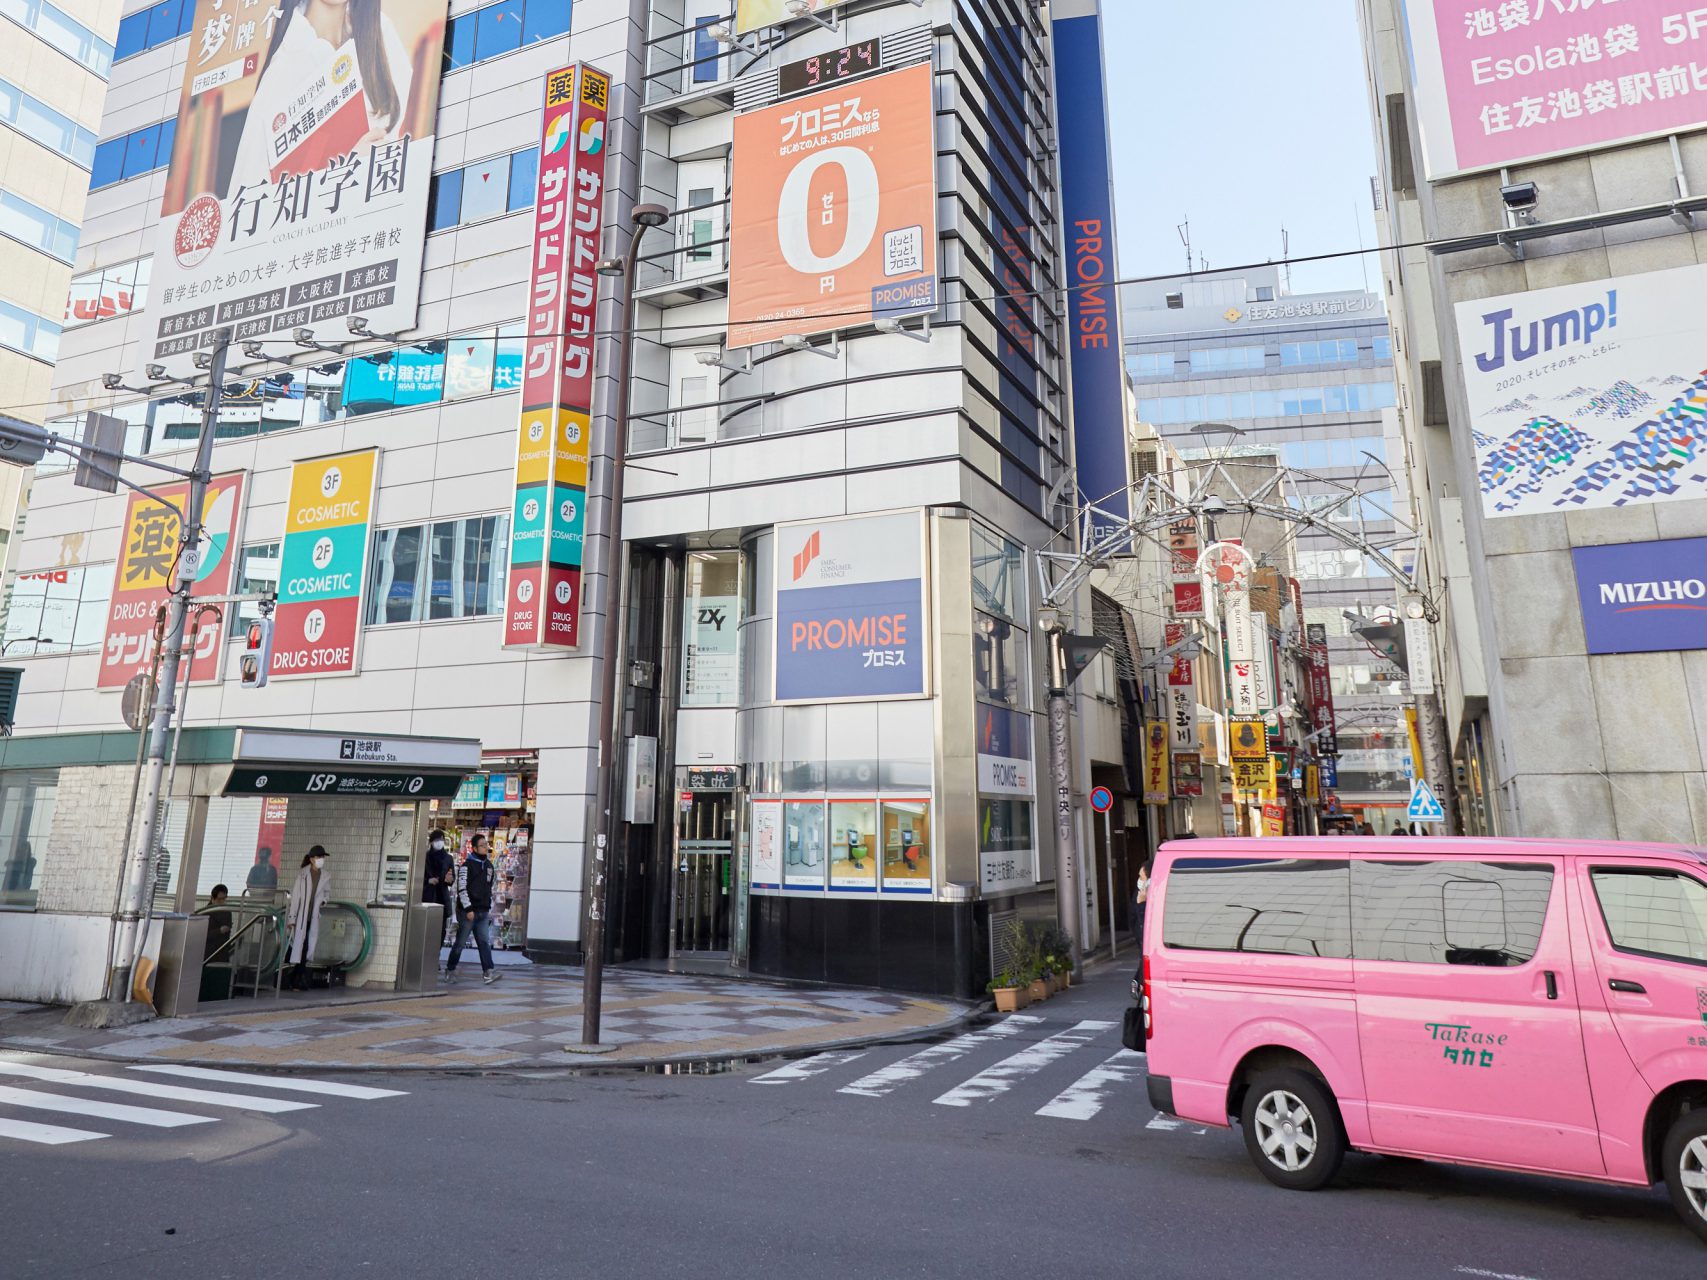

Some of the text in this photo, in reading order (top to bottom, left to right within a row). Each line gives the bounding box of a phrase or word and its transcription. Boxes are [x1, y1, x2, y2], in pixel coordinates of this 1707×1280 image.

[1471, 8, 1707, 85] Esola池袋 5F
[806, 42, 873, 85] 9:24
[194, 70, 227, 92] 行知日本
[549, 72, 573, 105] 薬
[583, 74, 606, 108] 薬
[780, 96, 880, 143] プロミスなら
[274, 107, 317, 158] 日本語
[230, 134, 410, 242] 行知学園
[778, 146, 880, 274] 0
[821, 192, 834, 226] ゼロ
[272, 216, 349, 244] COACH ACADEMY
[529, 167, 567, 379] サンドラッグ
[565, 167, 601, 379] サンドラッグ
[890, 256, 917, 271] プロミス
[351, 265, 389, 287] 京都校
[820, 276, 835, 294] 円
[1074, 219, 1109, 350] PROMISE
[297, 279, 333, 300] 大阪校
[875, 280, 932, 305] PROMISE
[222, 293, 280, 319] 高田马场校
[356, 291, 386, 309] 沈阳校
[910, 297, 931, 308] プロミス
[277, 312, 305, 327] 西安校
[315, 301, 345, 319] 武汉校
[1246, 298, 1375, 322] 住友池袋駅前ビル
[163, 310, 208, 334] 新宿本校
[239, 320, 267, 337] 天津校
[1475, 290, 1618, 373] Jump!
[159, 338, 195, 355] 上海总部
[530, 426, 542, 438] 3F
[568, 427, 580, 439] 3F
[519, 449, 550, 462] COSMETIC
[556, 449, 587, 464] COSMETIC
[324, 474, 339, 490] 3F
[297, 501, 360, 526] COSMETIC
[525, 504, 537, 516] 2F
[562, 505, 574, 517] 2F
[514, 529, 545, 541] COSMETIC
[551, 529, 583, 542] COSMETIC
[315, 544, 331, 561] 2F
[820, 564, 852, 573] CONSUMER
[820, 570, 845, 579] FINANCE
[288, 573, 352, 596] COSMETIC
[520, 585, 531, 597] 1F
[558, 587, 569, 598] 1F
[1600, 579, 1706, 604] MIZUHO
[114, 601, 146, 620] DRUG
[513, 611, 532, 621] DRUG
[553, 611, 571, 622] DRUG
[697, 608, 726, 632] ZXY
[308, 617, 321, 634] 1F
[512, 621, 533, 631] STORE
[551, 621, 571, 632] STORE
[791, 613, 907, 652] PROMISE
[106, 623, 219, 665] サンドグ
[273, 648, 350, 670] DRUG STORE
[862, 649, 906, 669] プロミス
[1240, 685, 1251, 705] 天狗
[357, 741, 382, 752] 池袋駅
[356, 752, 398, 762] Ikebukuro Sta.
[993, 763, 1017, 787] PROMISE
[1054, 708, 1071, 841] サンシャイン中央通り
[1239, 764, 1264, 775] 金沢
[306, 773, 337, 792] ISP
[338, 777, 403, 789] 池袋ショッピングパーク
[412, 778, 420, 790] P
[1236, 777, 1269, 787] カレー
[1425, 1022, 1508, 1047] Takase
[1443, 1046, 1494, 1068] タカセ
